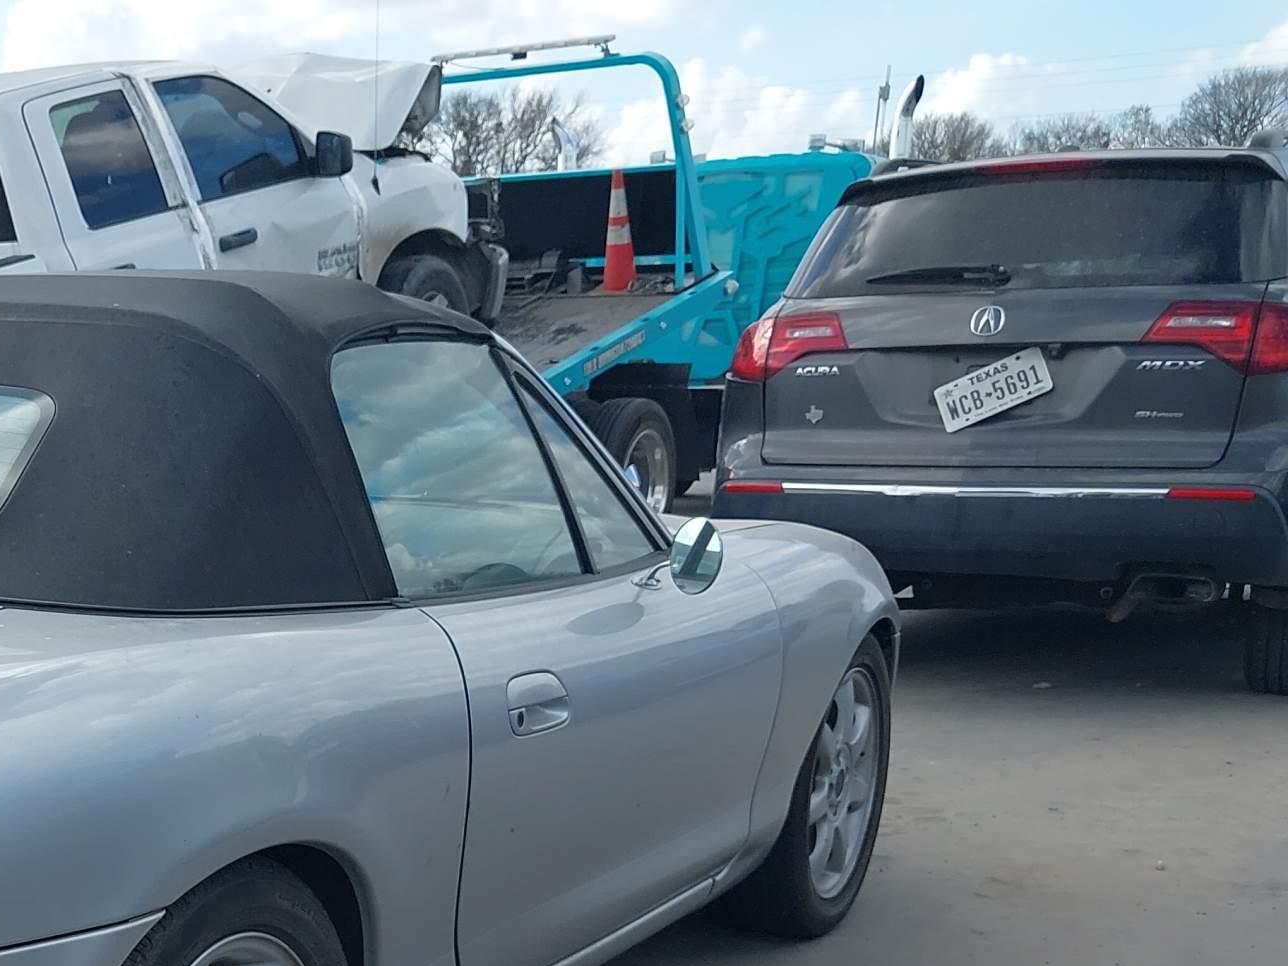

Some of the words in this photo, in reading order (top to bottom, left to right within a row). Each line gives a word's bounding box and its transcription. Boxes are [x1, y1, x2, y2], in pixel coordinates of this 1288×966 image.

[1135, 360, 1207, 371] MDX
[795, 366, 840, 377] ACURA
[967, 362, 1009, 386] TEXAS
